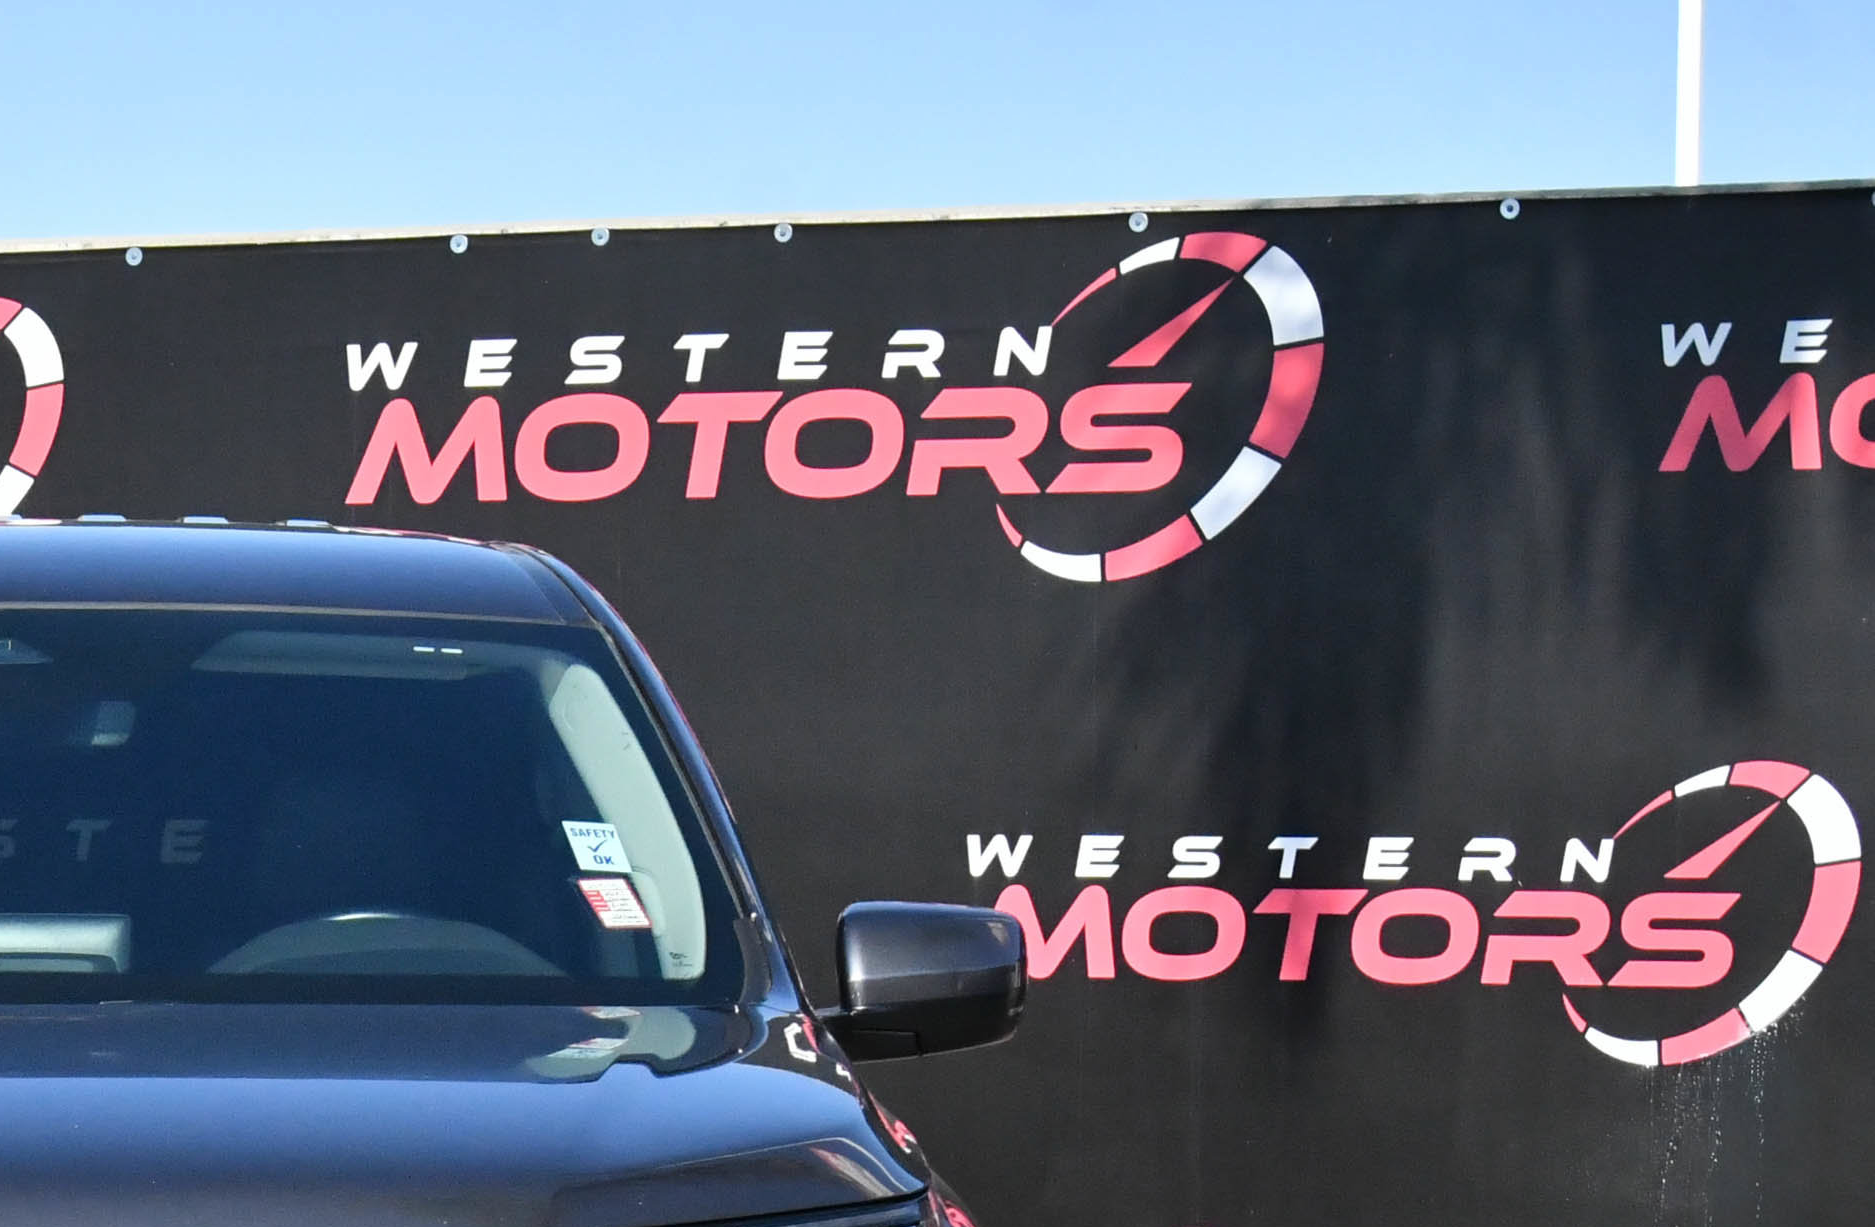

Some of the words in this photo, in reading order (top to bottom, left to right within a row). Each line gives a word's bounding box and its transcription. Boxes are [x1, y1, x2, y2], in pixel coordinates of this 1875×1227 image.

[346, 325, 1053, 392] WESTERN
[345, 381, 1193, 506] MOTORS
[569, 827, 615, 839] SAFETY
[592, 854, 615, 865] OK
[966, 833, 1615, 883] WESTERN
[993, 883, 1742, 989] MOTORS
